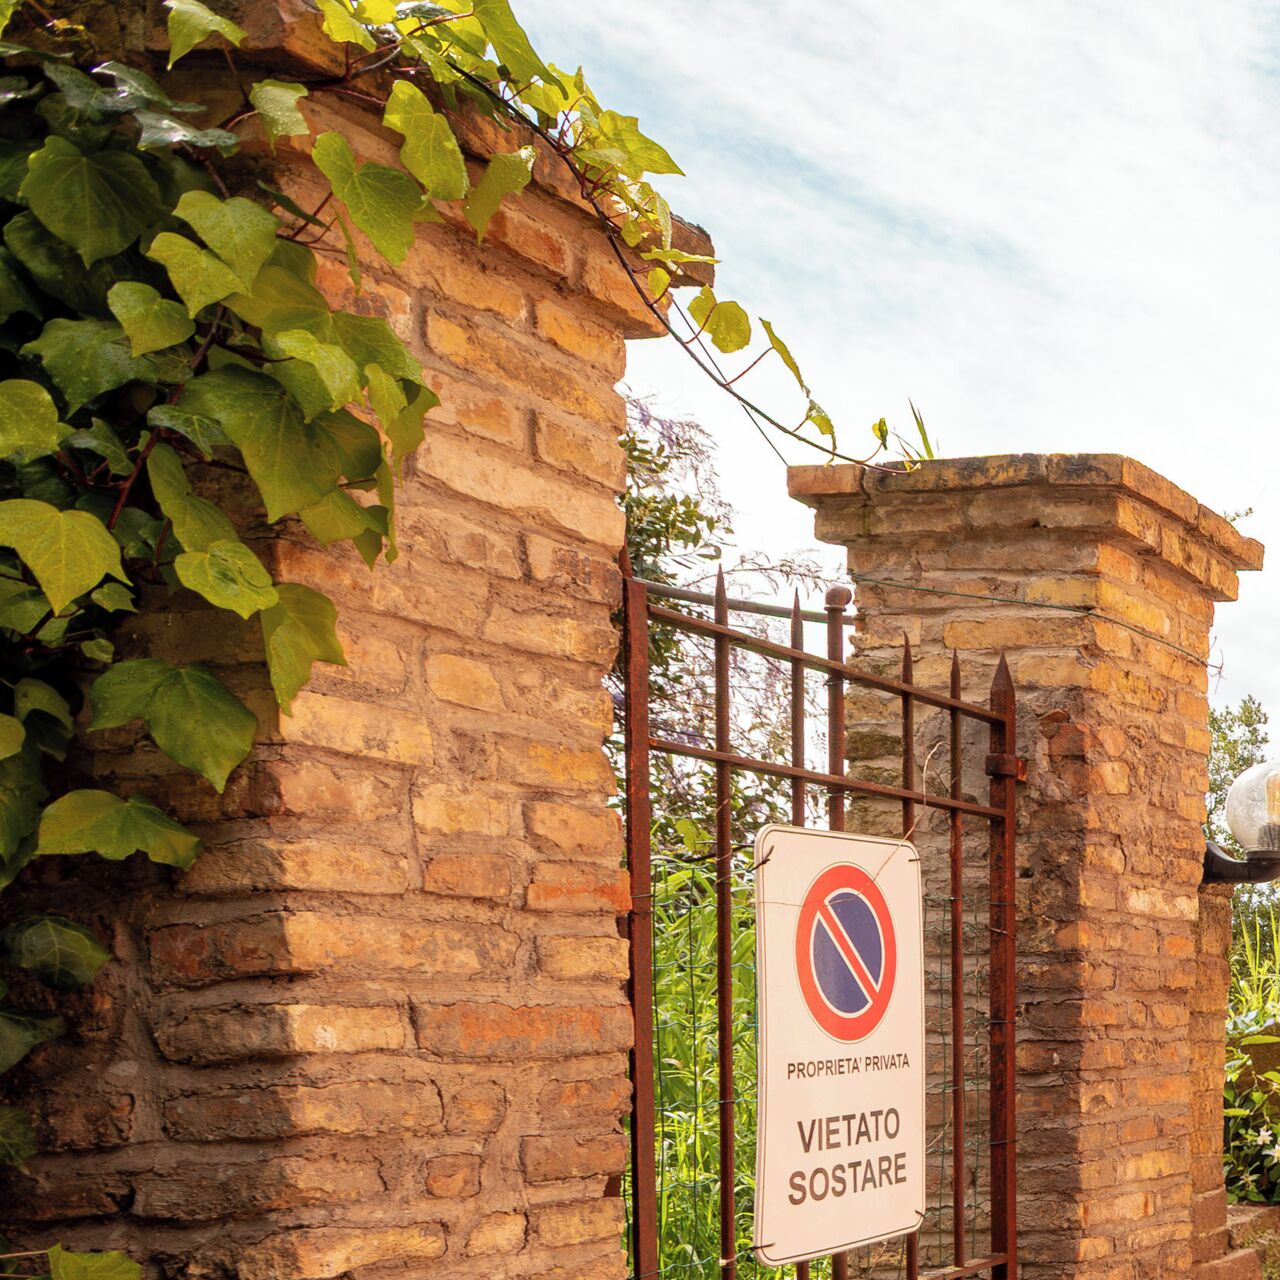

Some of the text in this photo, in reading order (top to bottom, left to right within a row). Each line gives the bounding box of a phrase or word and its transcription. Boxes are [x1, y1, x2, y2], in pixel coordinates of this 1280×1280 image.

[787, 1053, 910, 1080] PROPRIETA' PRIVATA
[797, 1107, 900, 1154] VIETATO
[788, 1152, 907, 1206] SOSTARE
